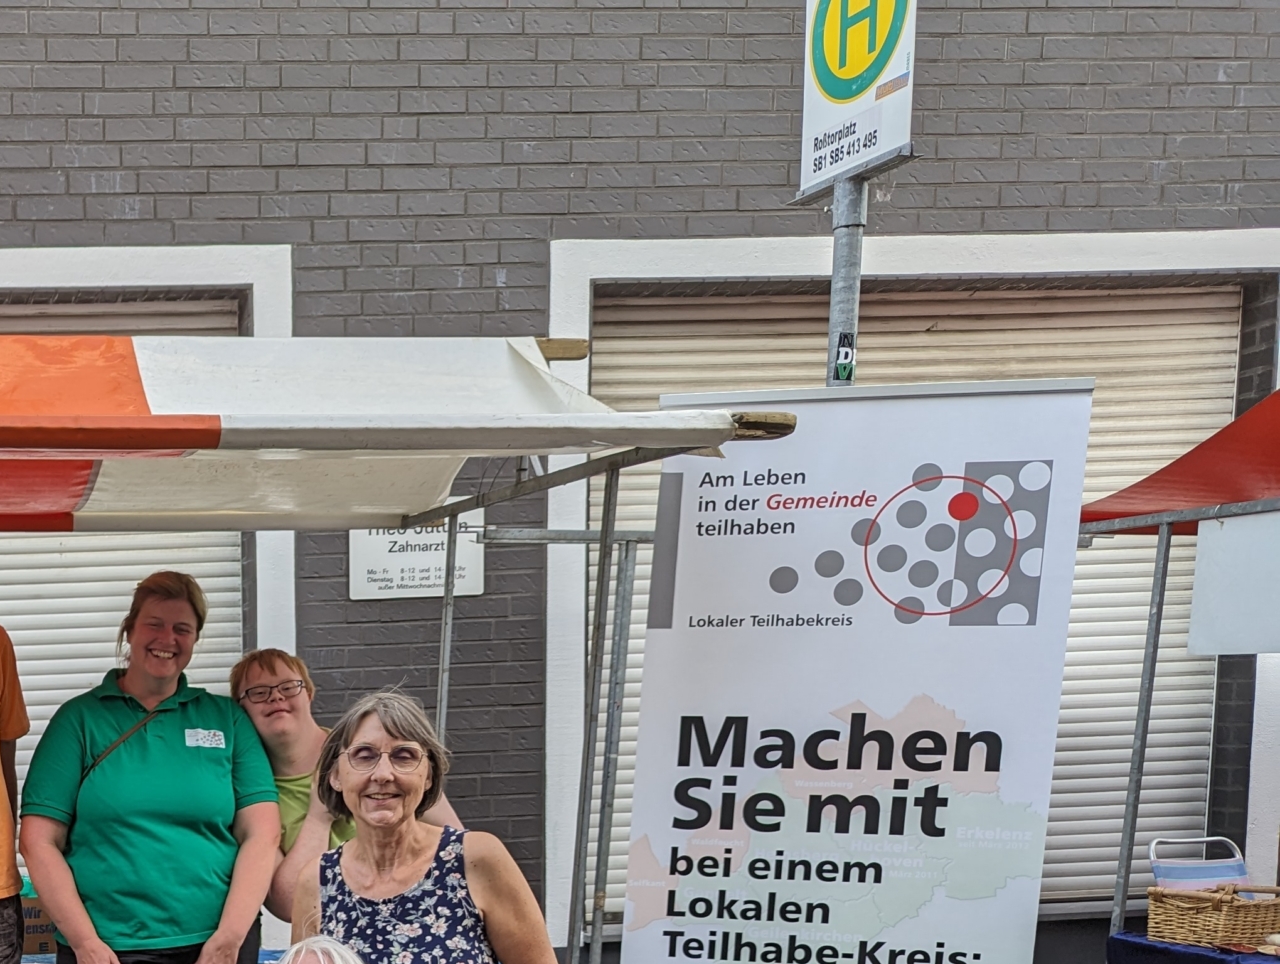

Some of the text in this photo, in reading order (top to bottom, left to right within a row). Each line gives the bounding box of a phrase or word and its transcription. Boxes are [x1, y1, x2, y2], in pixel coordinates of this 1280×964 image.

[838, 0, 878, 71] H
[813, 121, 857, 153] Roßtorplatz
[812, 129, 878, 174] SB1 SB5 413 495
[699, 468, 807, 488] Am Leben
[698, 490, 878, 512] in der Gemeinde
[696, 517, 796, 537] teilhaben
[387, 540, 446, 553] Zahnarzt
[366, 576, 394, 584] Dienstag
[688, 613, 853, 628] Lokaler Teilhabekreis
[676, 713, 1003, 773] Machen
[794, 779, 854, 790] Wassenberg
[672, 776, 949, 838] Sie mit
[956, 826, 1034, 841] Erkelenz
[669, 846, 883, 884] bei einem
[665, 889, 831, 925] Lokalen
